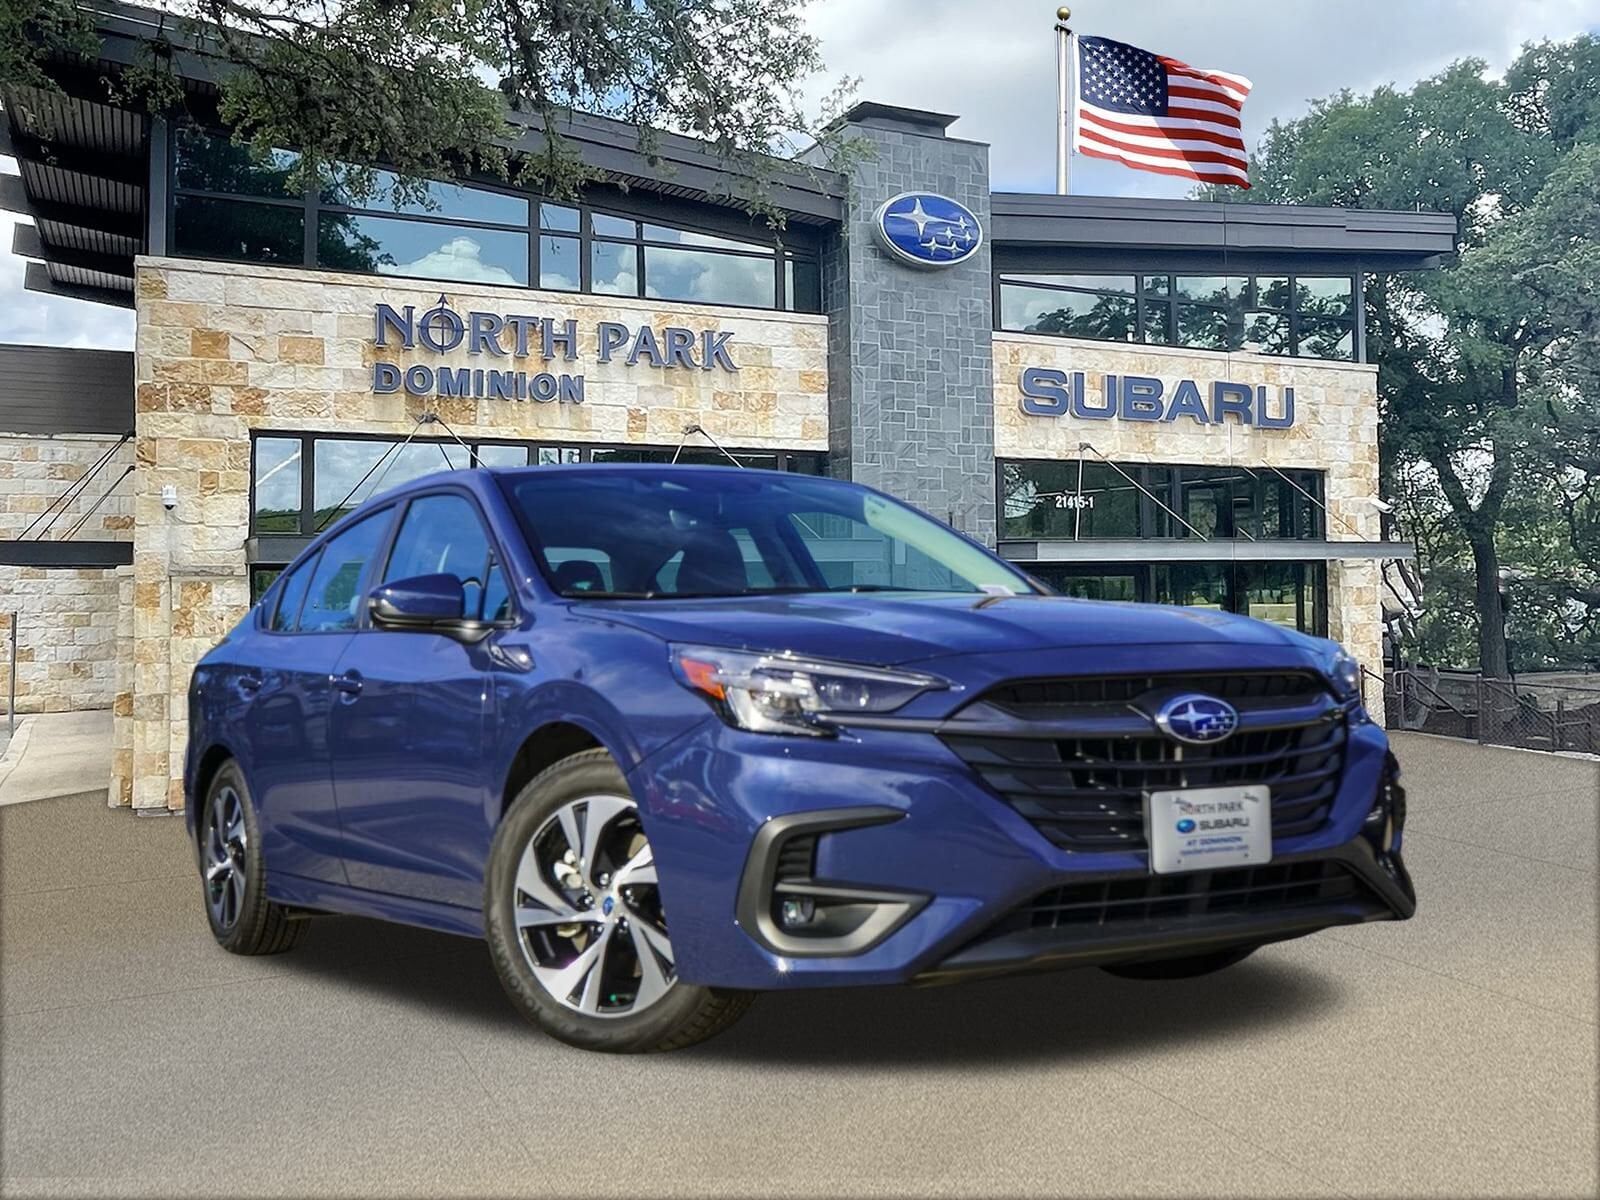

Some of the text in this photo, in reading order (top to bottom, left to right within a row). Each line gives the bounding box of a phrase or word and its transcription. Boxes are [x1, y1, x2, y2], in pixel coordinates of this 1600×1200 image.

[374, 294, 742, 373] NORTH PARK
[372, 362, 585, 404] DOMINION
[1018, 367, 1294, 430] SUBARU
[1199, 817, 1250, 831] SUBARU
[1217, 801, 1244, 813] PARK
